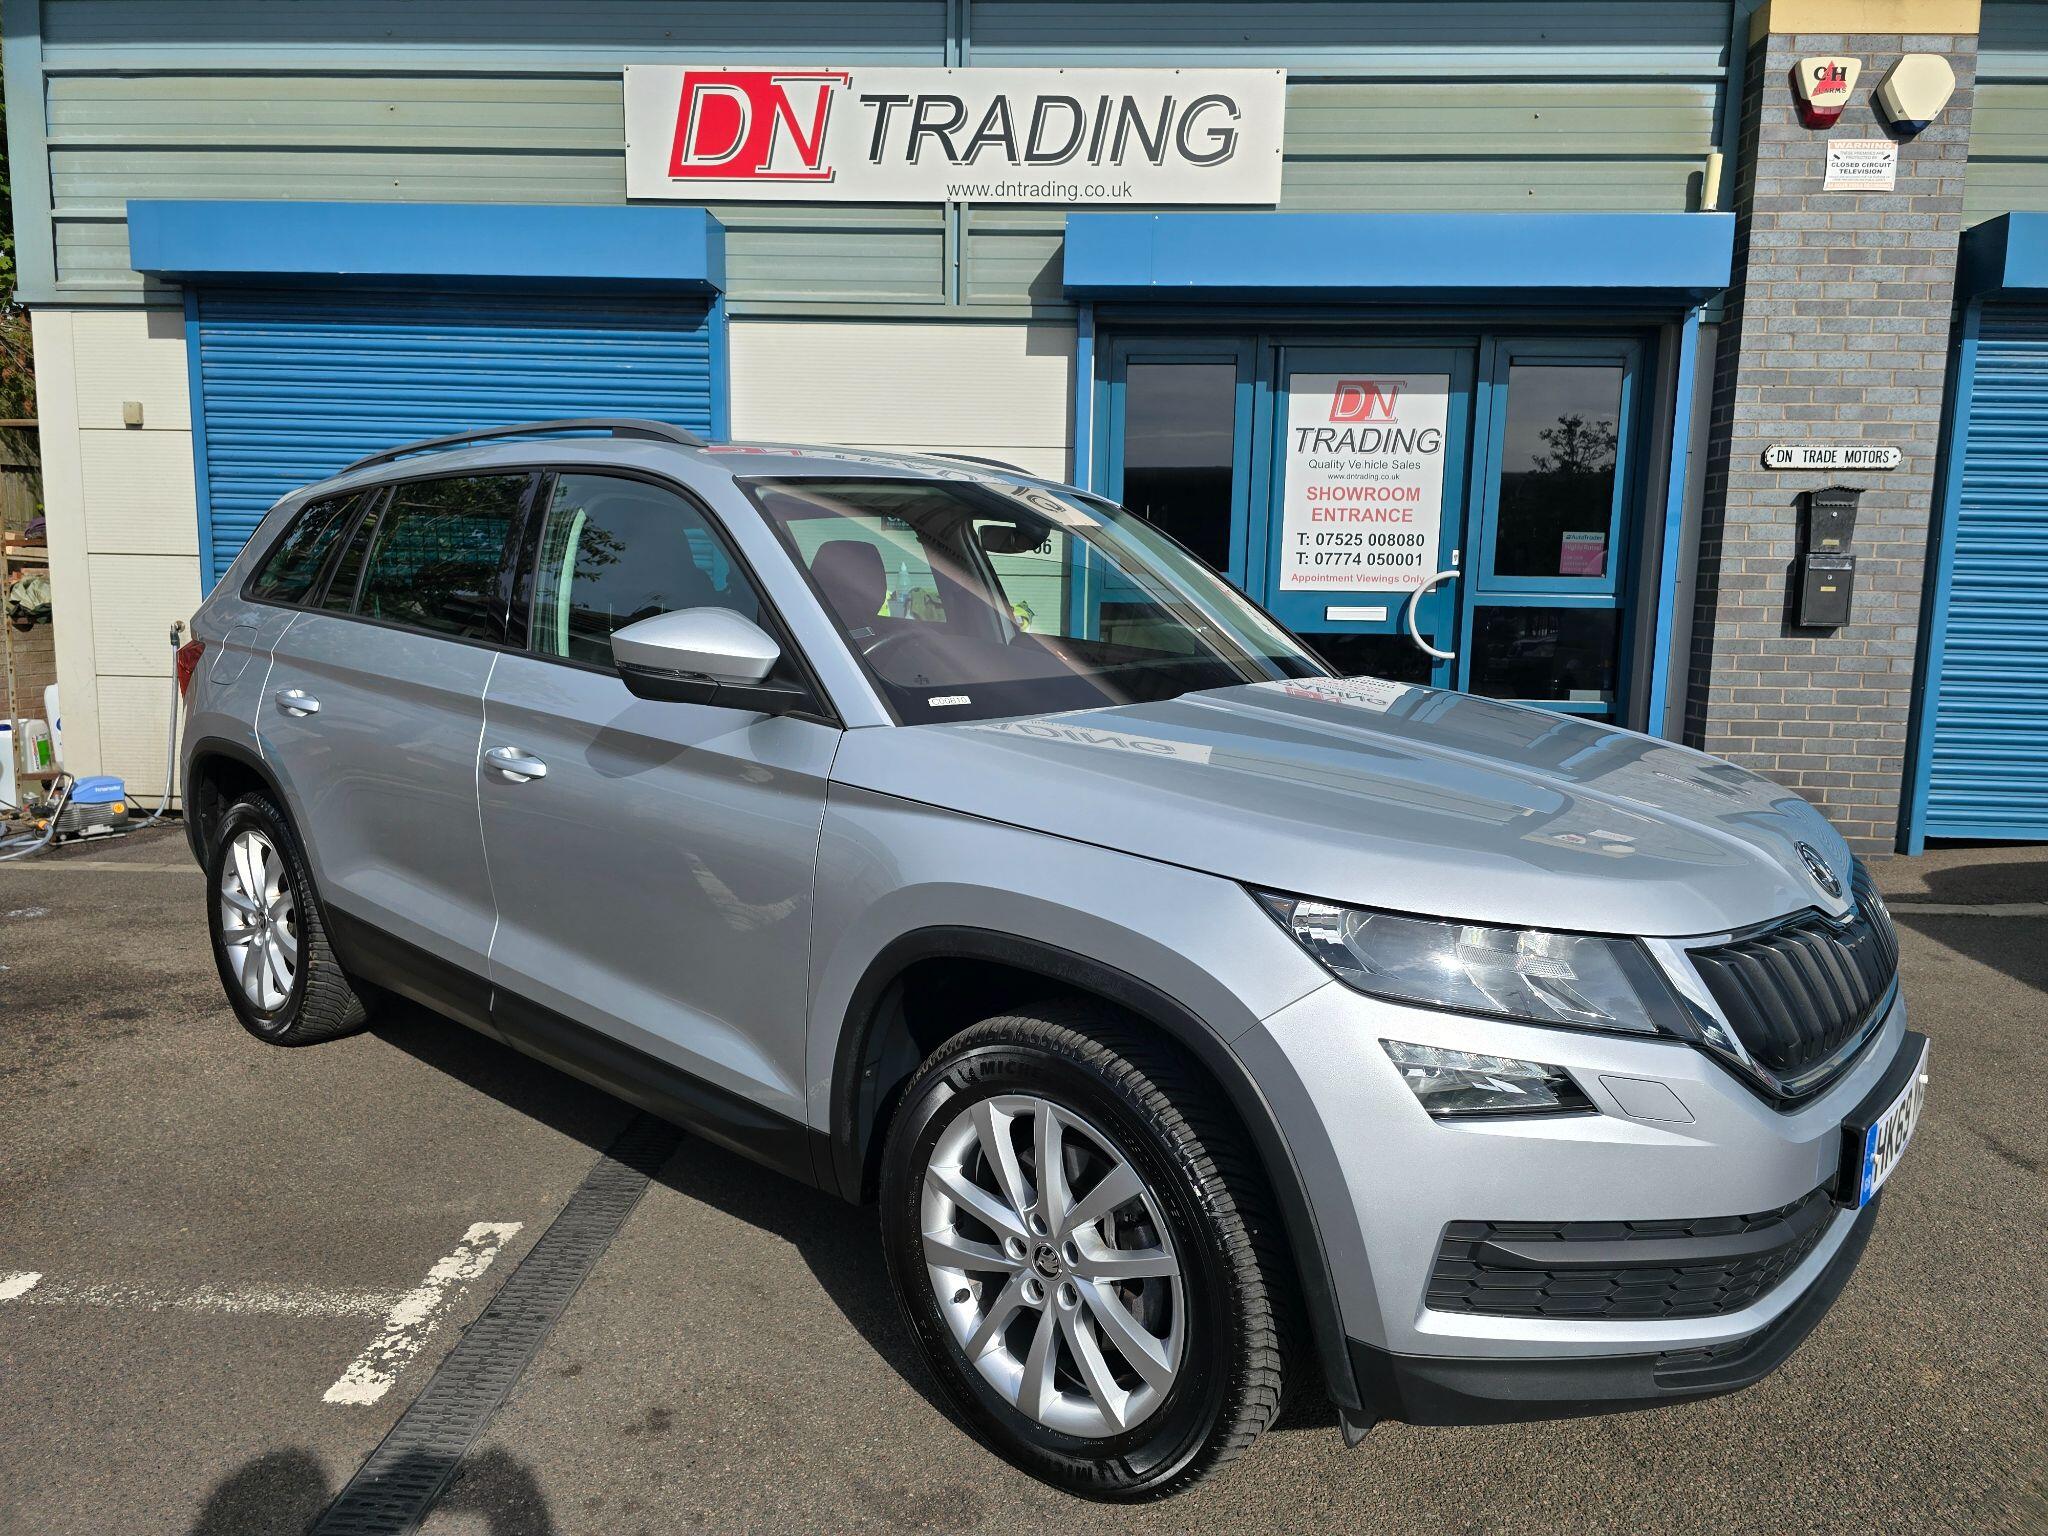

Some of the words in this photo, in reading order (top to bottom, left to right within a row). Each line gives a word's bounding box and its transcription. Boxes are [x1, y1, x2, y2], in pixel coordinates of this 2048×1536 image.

[683, 72, 853, 171] DN
[859, 93, 1242, 167] TRADING
[946, 180, 1133, 200] www.dntrading.co.uk
[1332, 380, 1407, 421] DN
[1295, 427, 1442, 454] TRADING
[1776, 449, 1793, 463] DN
[1803, 449, 1837, 463] TRADE
[1844, 450, 1890, 463] MOTORS
[1308, 459, 1345, 471] Quality
[1391, 459, 1421, 470] Sales
[1327, 473, 1400, 481] www.dntrading.co.uk
[1306, 486, 1421, 501] SHOWROOM
[1311, 507, 1413, 522] ENTRANCE
[1297, 532, 1310, 546] T:
[1315, 533, 1363, 546] 07525
[1368, 533, 1425, 547] 008080
[1296, 552, 1309, 565] T:
[1314, 552, 1362, 565] 07774
[1366, 553, 1422, 566] 050001
[1291, 573, 1353, 583] Appointment
[1356, 574, 1400, 584] Viewings
[1402, 574, 1425, 584] Only
